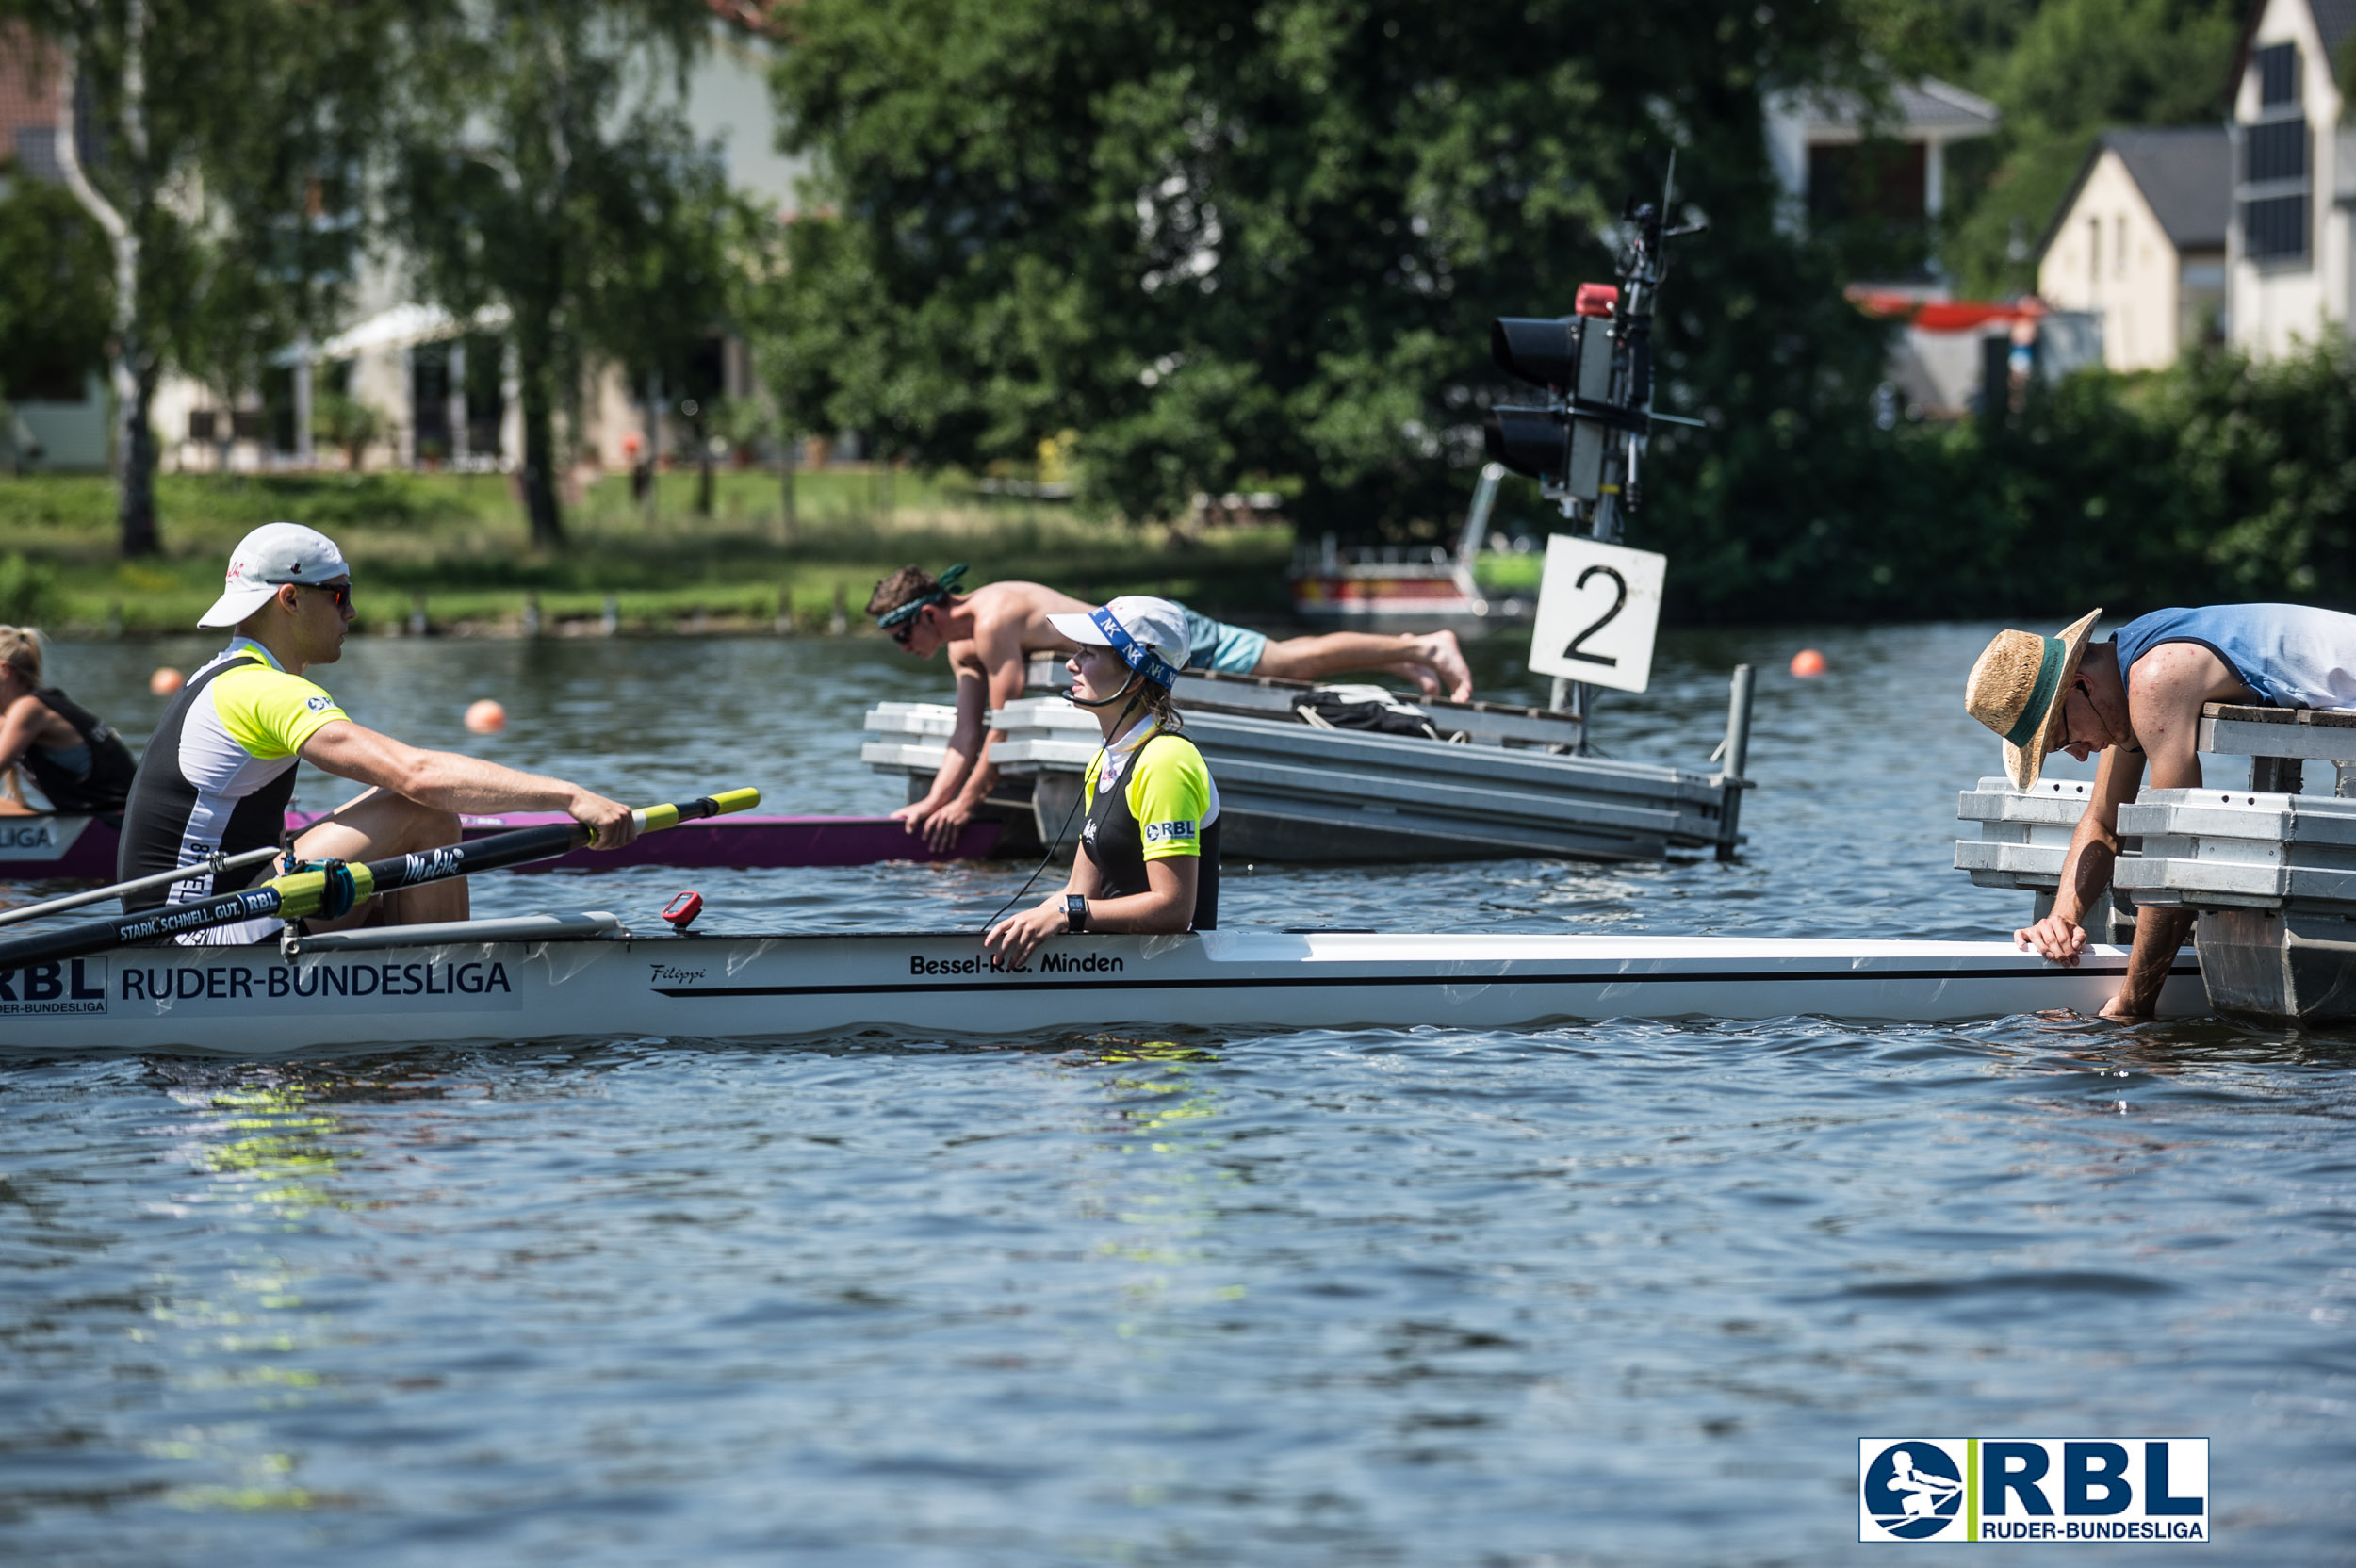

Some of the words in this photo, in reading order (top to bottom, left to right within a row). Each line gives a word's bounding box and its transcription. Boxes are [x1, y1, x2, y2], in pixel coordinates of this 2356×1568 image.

[1562, 565, 1628, 667] 2
[1100, 617, 1121, 638] NK
[1122, 642, 1144, 665] NK
[1146, 662, 1165, 678] NK
[1161, 821, 1195, 836] RBL
[400, 848, 460, 886] Melitta
[120, 921, 159, 941] STARK.
[160, 908, 214, 932] SCHNELL.
[215, 902, 241, 920] GUT.
[246, 891, 278, 911] RBL
[650, 964, 706, 984] Filippi
[1039, 952, 1124, 972] Minden
[122, 961, 512, 1002] RUDER-BUNDESLIGA
[0, 1002, 105, 1014] ER-BUNDESLIGA
